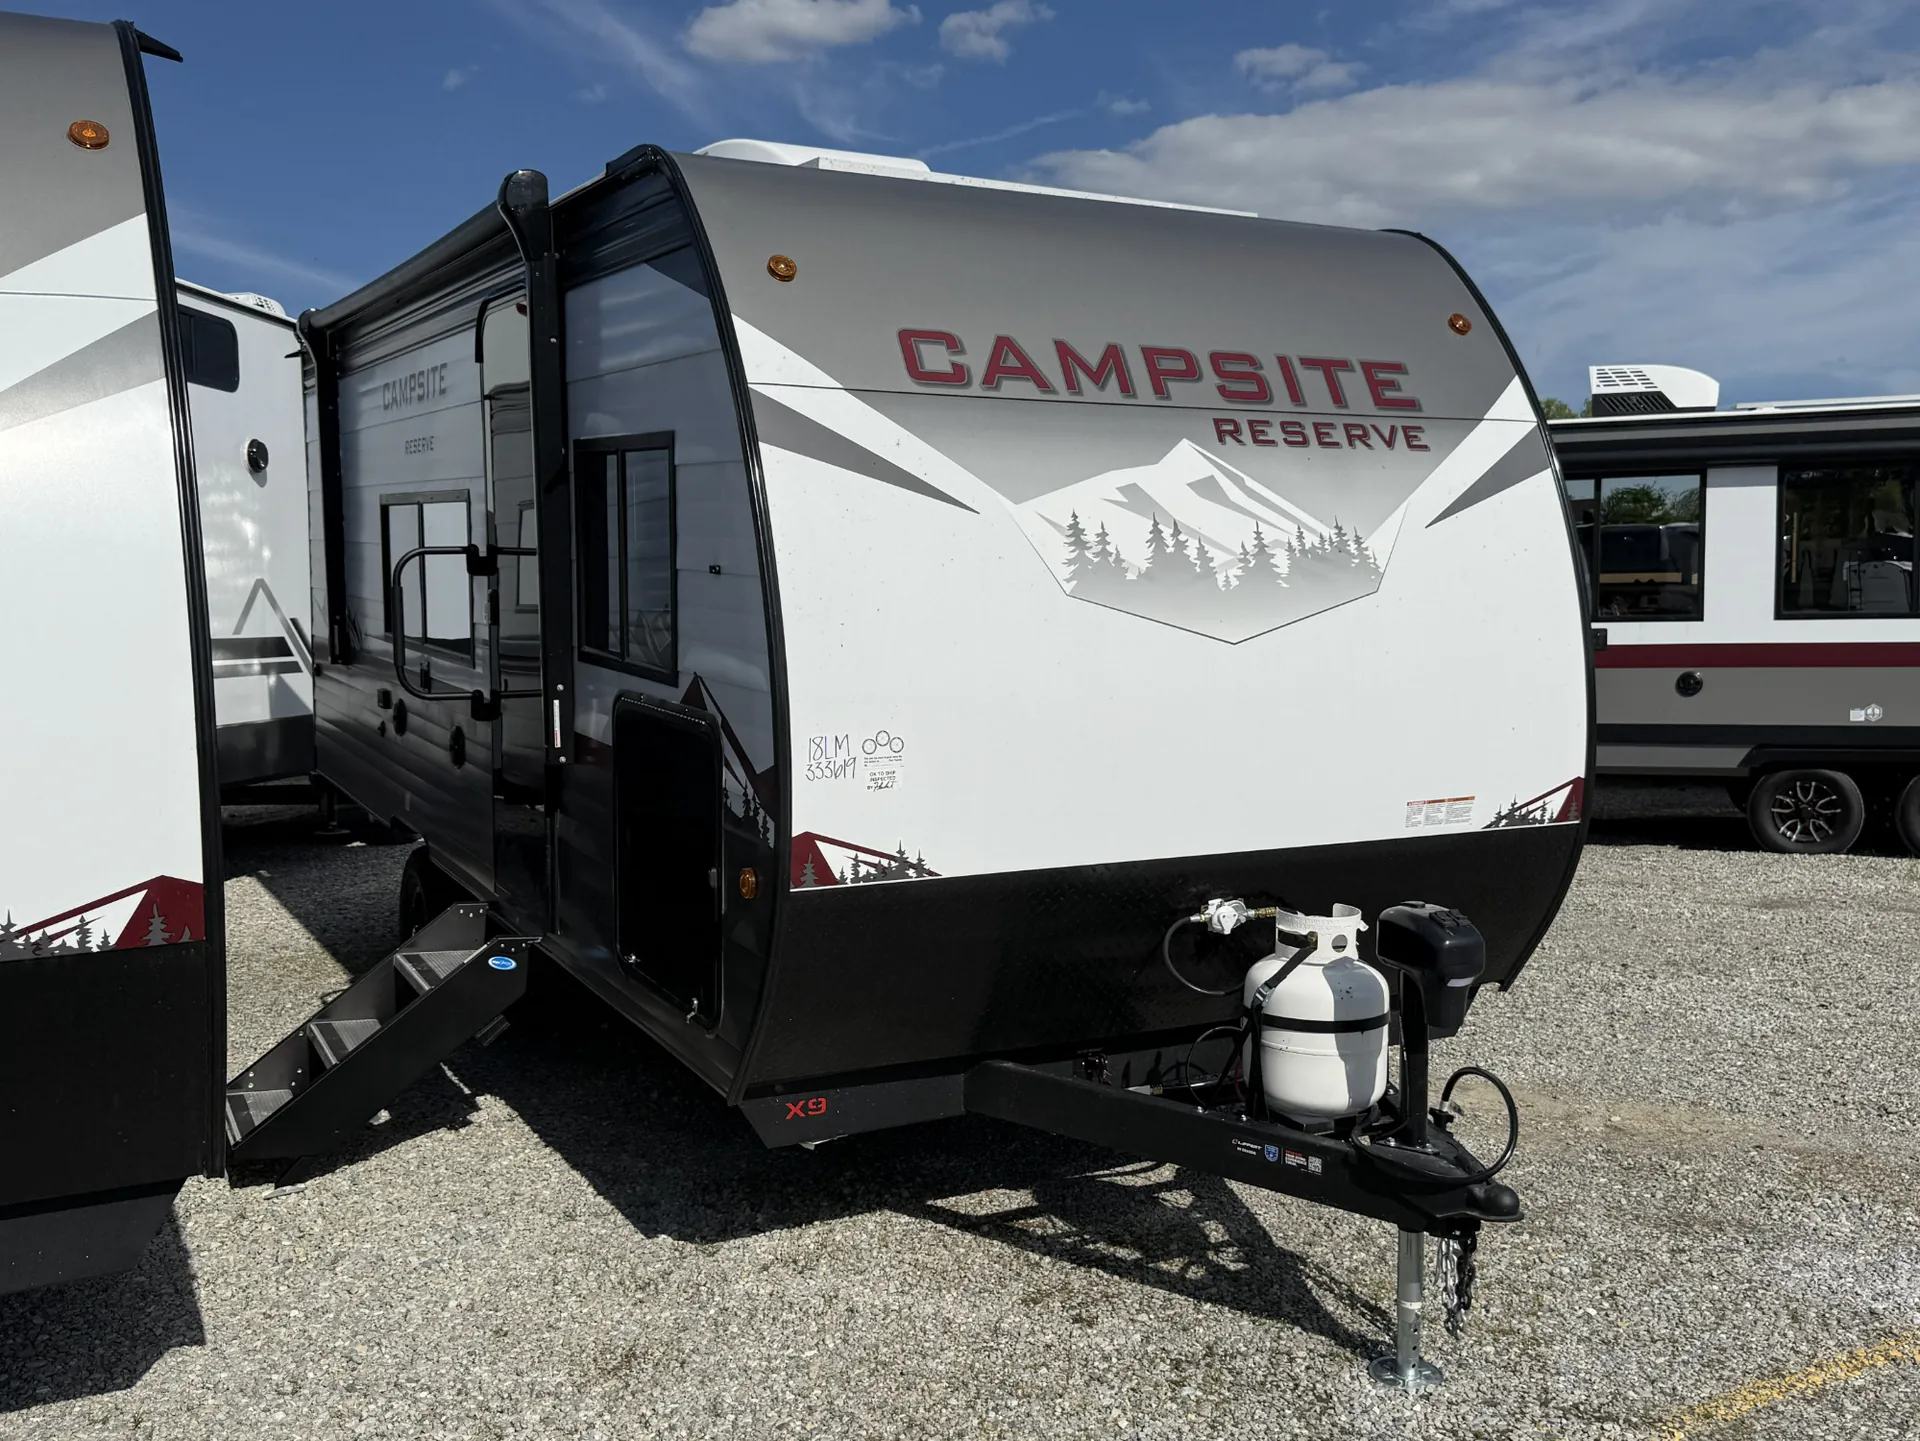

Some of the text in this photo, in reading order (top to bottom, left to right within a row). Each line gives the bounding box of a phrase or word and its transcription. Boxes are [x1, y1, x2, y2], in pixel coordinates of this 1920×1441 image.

[897, 328, 1423, 412] CAMPSITE
[383, 362, 448, 411] CAMPSITE
[404, 435, 435, 455] RESERVE
[1212, 417, 1431, 451] RESERVE
[808, 733, 850, 763] 18LM
[805, 756, 857, 782] 333619
[785, 1097, 827, 1120] X9
